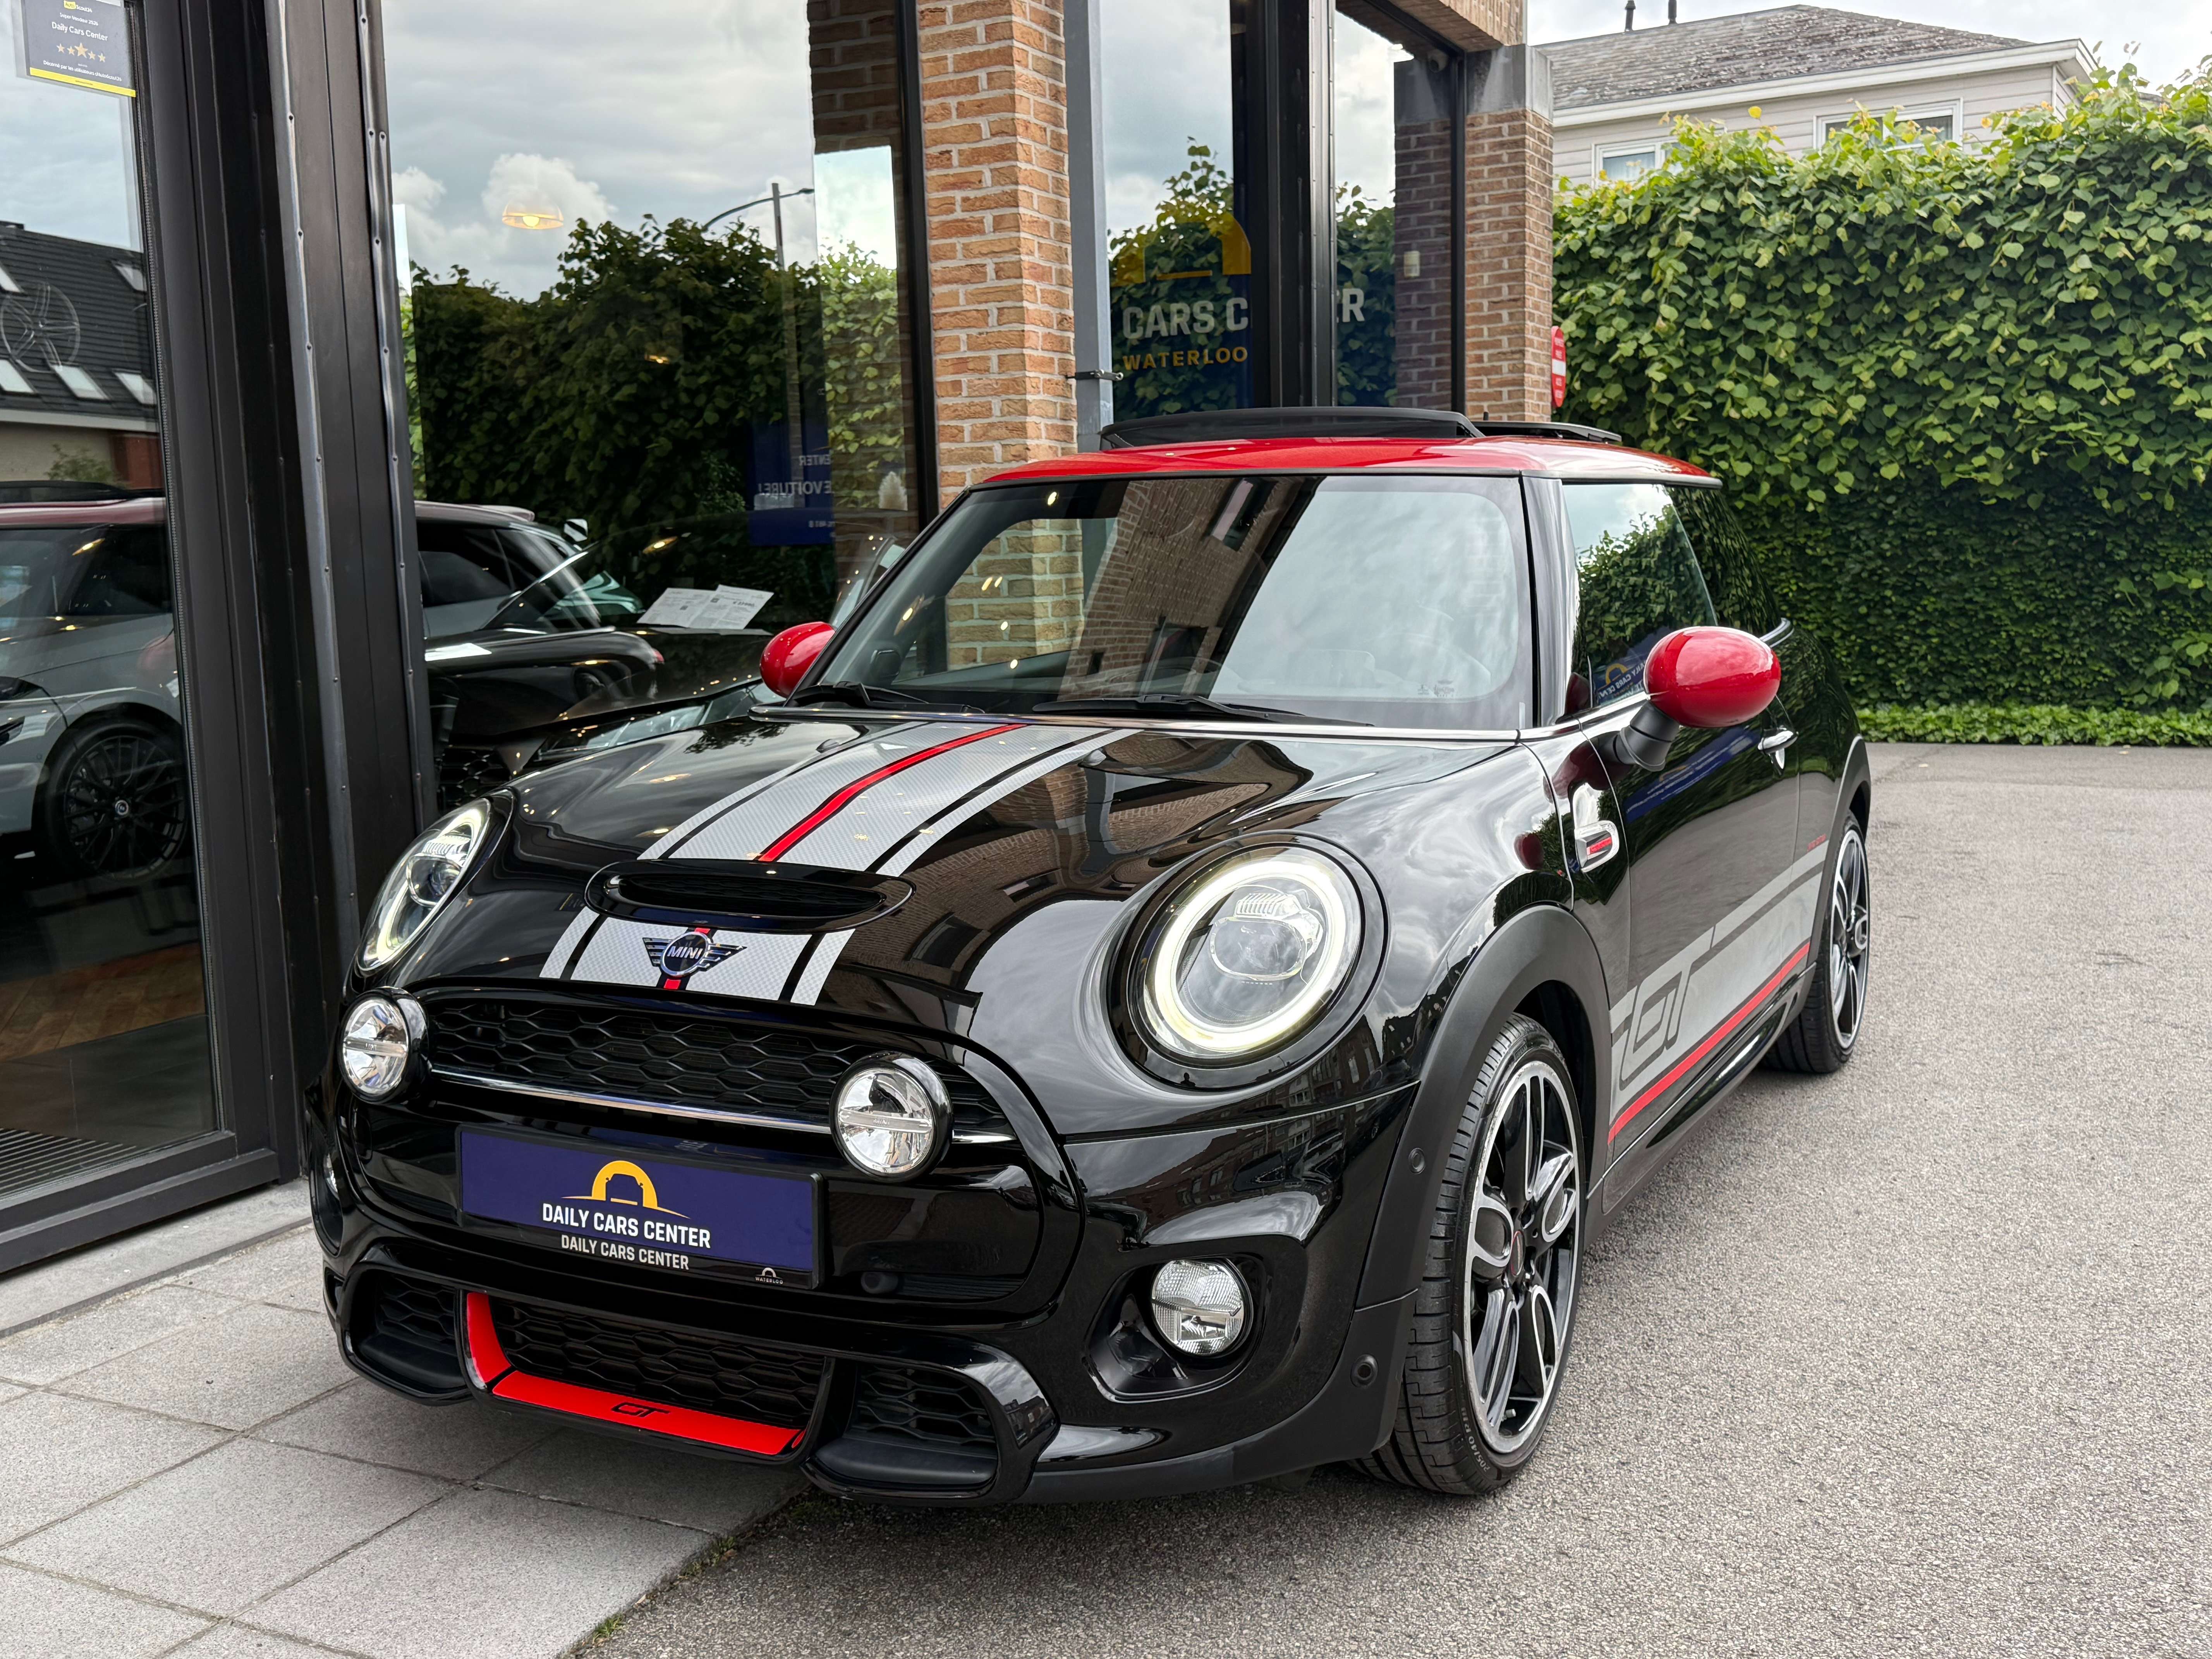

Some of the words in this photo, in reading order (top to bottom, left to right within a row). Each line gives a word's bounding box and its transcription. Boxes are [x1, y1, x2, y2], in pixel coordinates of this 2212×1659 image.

[52, 22, 68, 33] Daily
[69, 26, 84, 35] Cars
[86, 30, 108, 41] Center
[1122, 300, 1214, 339] CARS
[1122, 346, 1248, 371] WATERLOO
[667, 946, 703, 959] MINI
[543, 1203, 589, 1228] DAILY
[594, 1212, 638, 1237] CARS
[644, 1221, 711, 1249] CENTER
[562, 1234, 598, 1254] DAILY
[601, 1242, 635, 1261] CARS
[639, 1249, 689, 1270] CENTER
[611, 1401, 670, 1418] GT
[1468, 1436, 1490, 1472] 205/40
